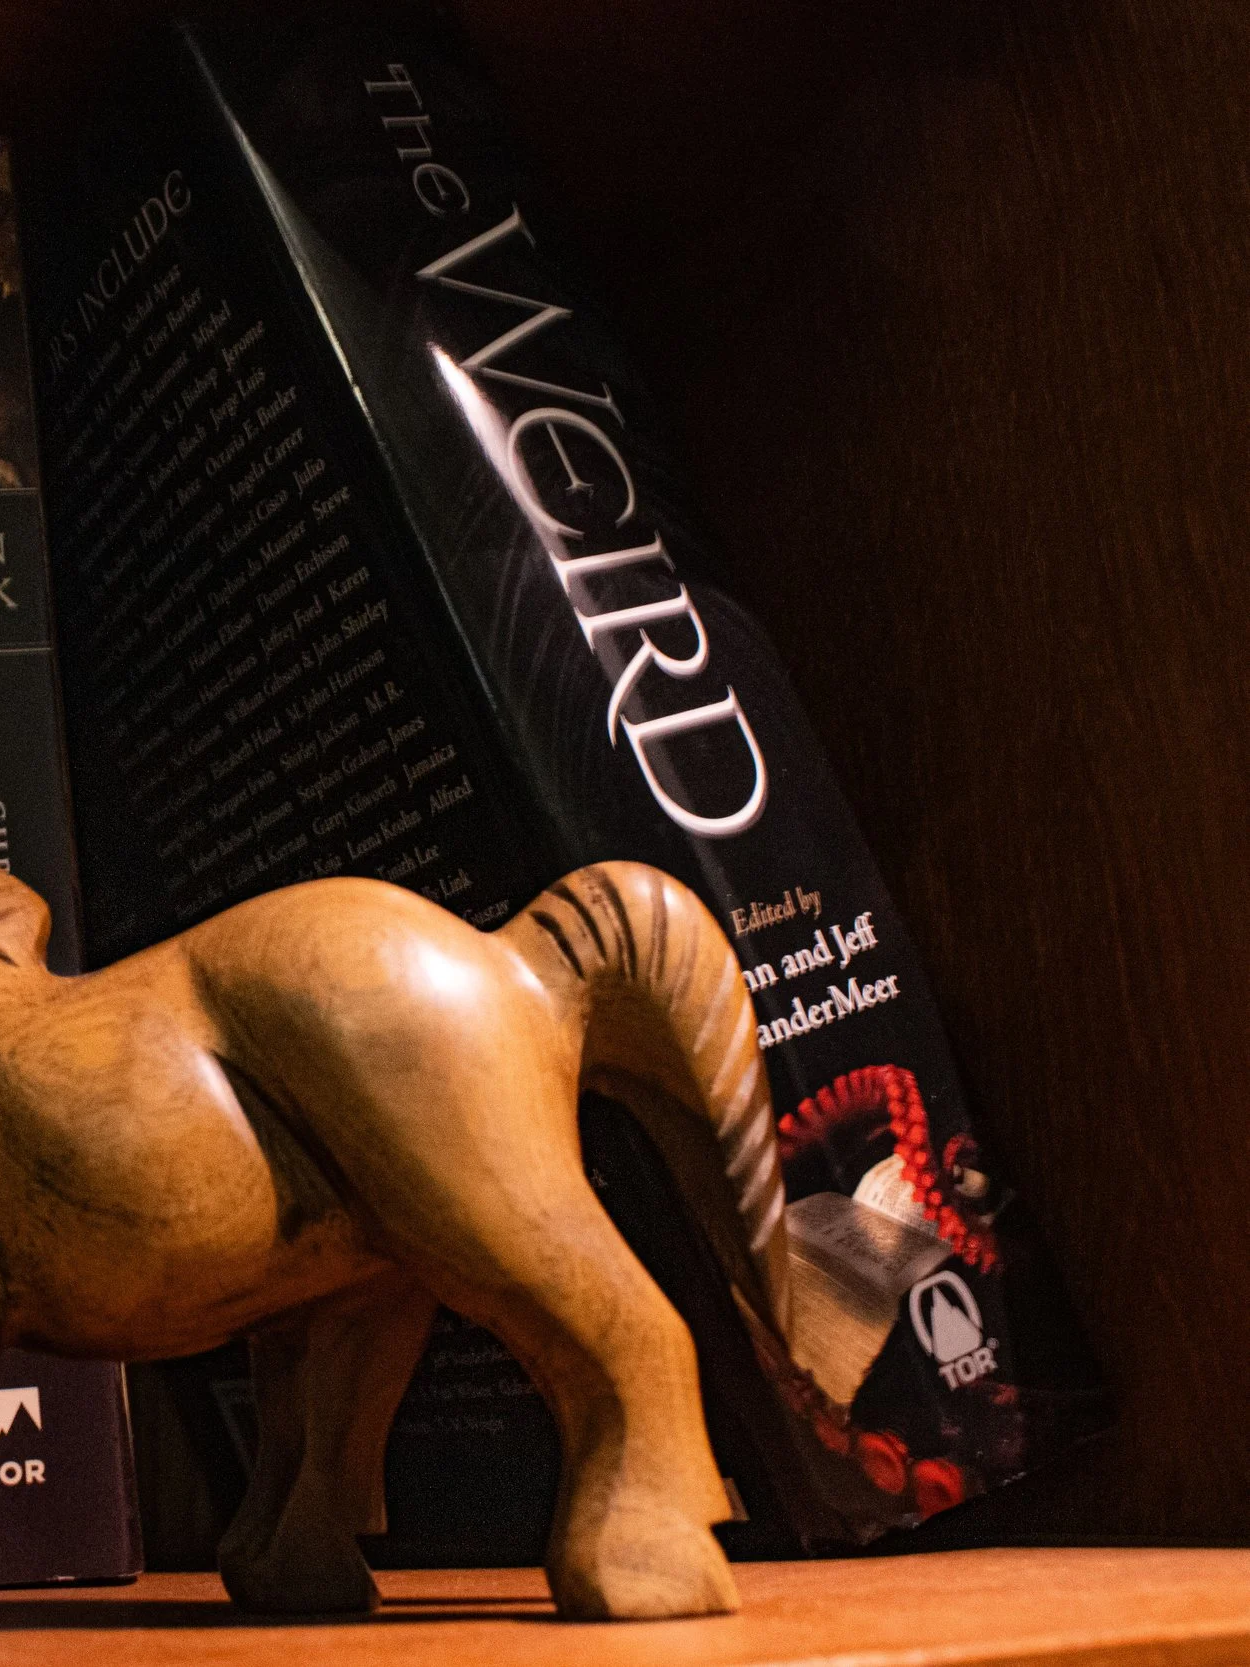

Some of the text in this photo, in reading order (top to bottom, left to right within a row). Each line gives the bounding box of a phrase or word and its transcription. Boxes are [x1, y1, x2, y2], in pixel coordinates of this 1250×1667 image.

[364, 64, 469, 217] The
[255, 385, 296, 427] Butler
[262, 427, 303, 466] Carter
[291, 458, 325, 498] Julio
[311, 485, 350, 521] Steve
[292, 594, 323, 630] Ford
[327, 566, 369, 602] Karen
[311, 633, 342, 666] John
[340, 598, 388, 639] Shirley
[364, 690, 383, 714] M.
[383, 680, 404, 702] R.
[386, 715, 425, 752] Jones
[402, 743, 456, 789] Jamaica
[429, 774, 473, 814] Alfred
[730, 885, 822, 937] Edited by
[781, 928, 835, 980] and
[829, 911, 879, 970] Jeff
[756, 974, 901, 1050] anderMeer
[938, 1347, 998, 1391] TOR
